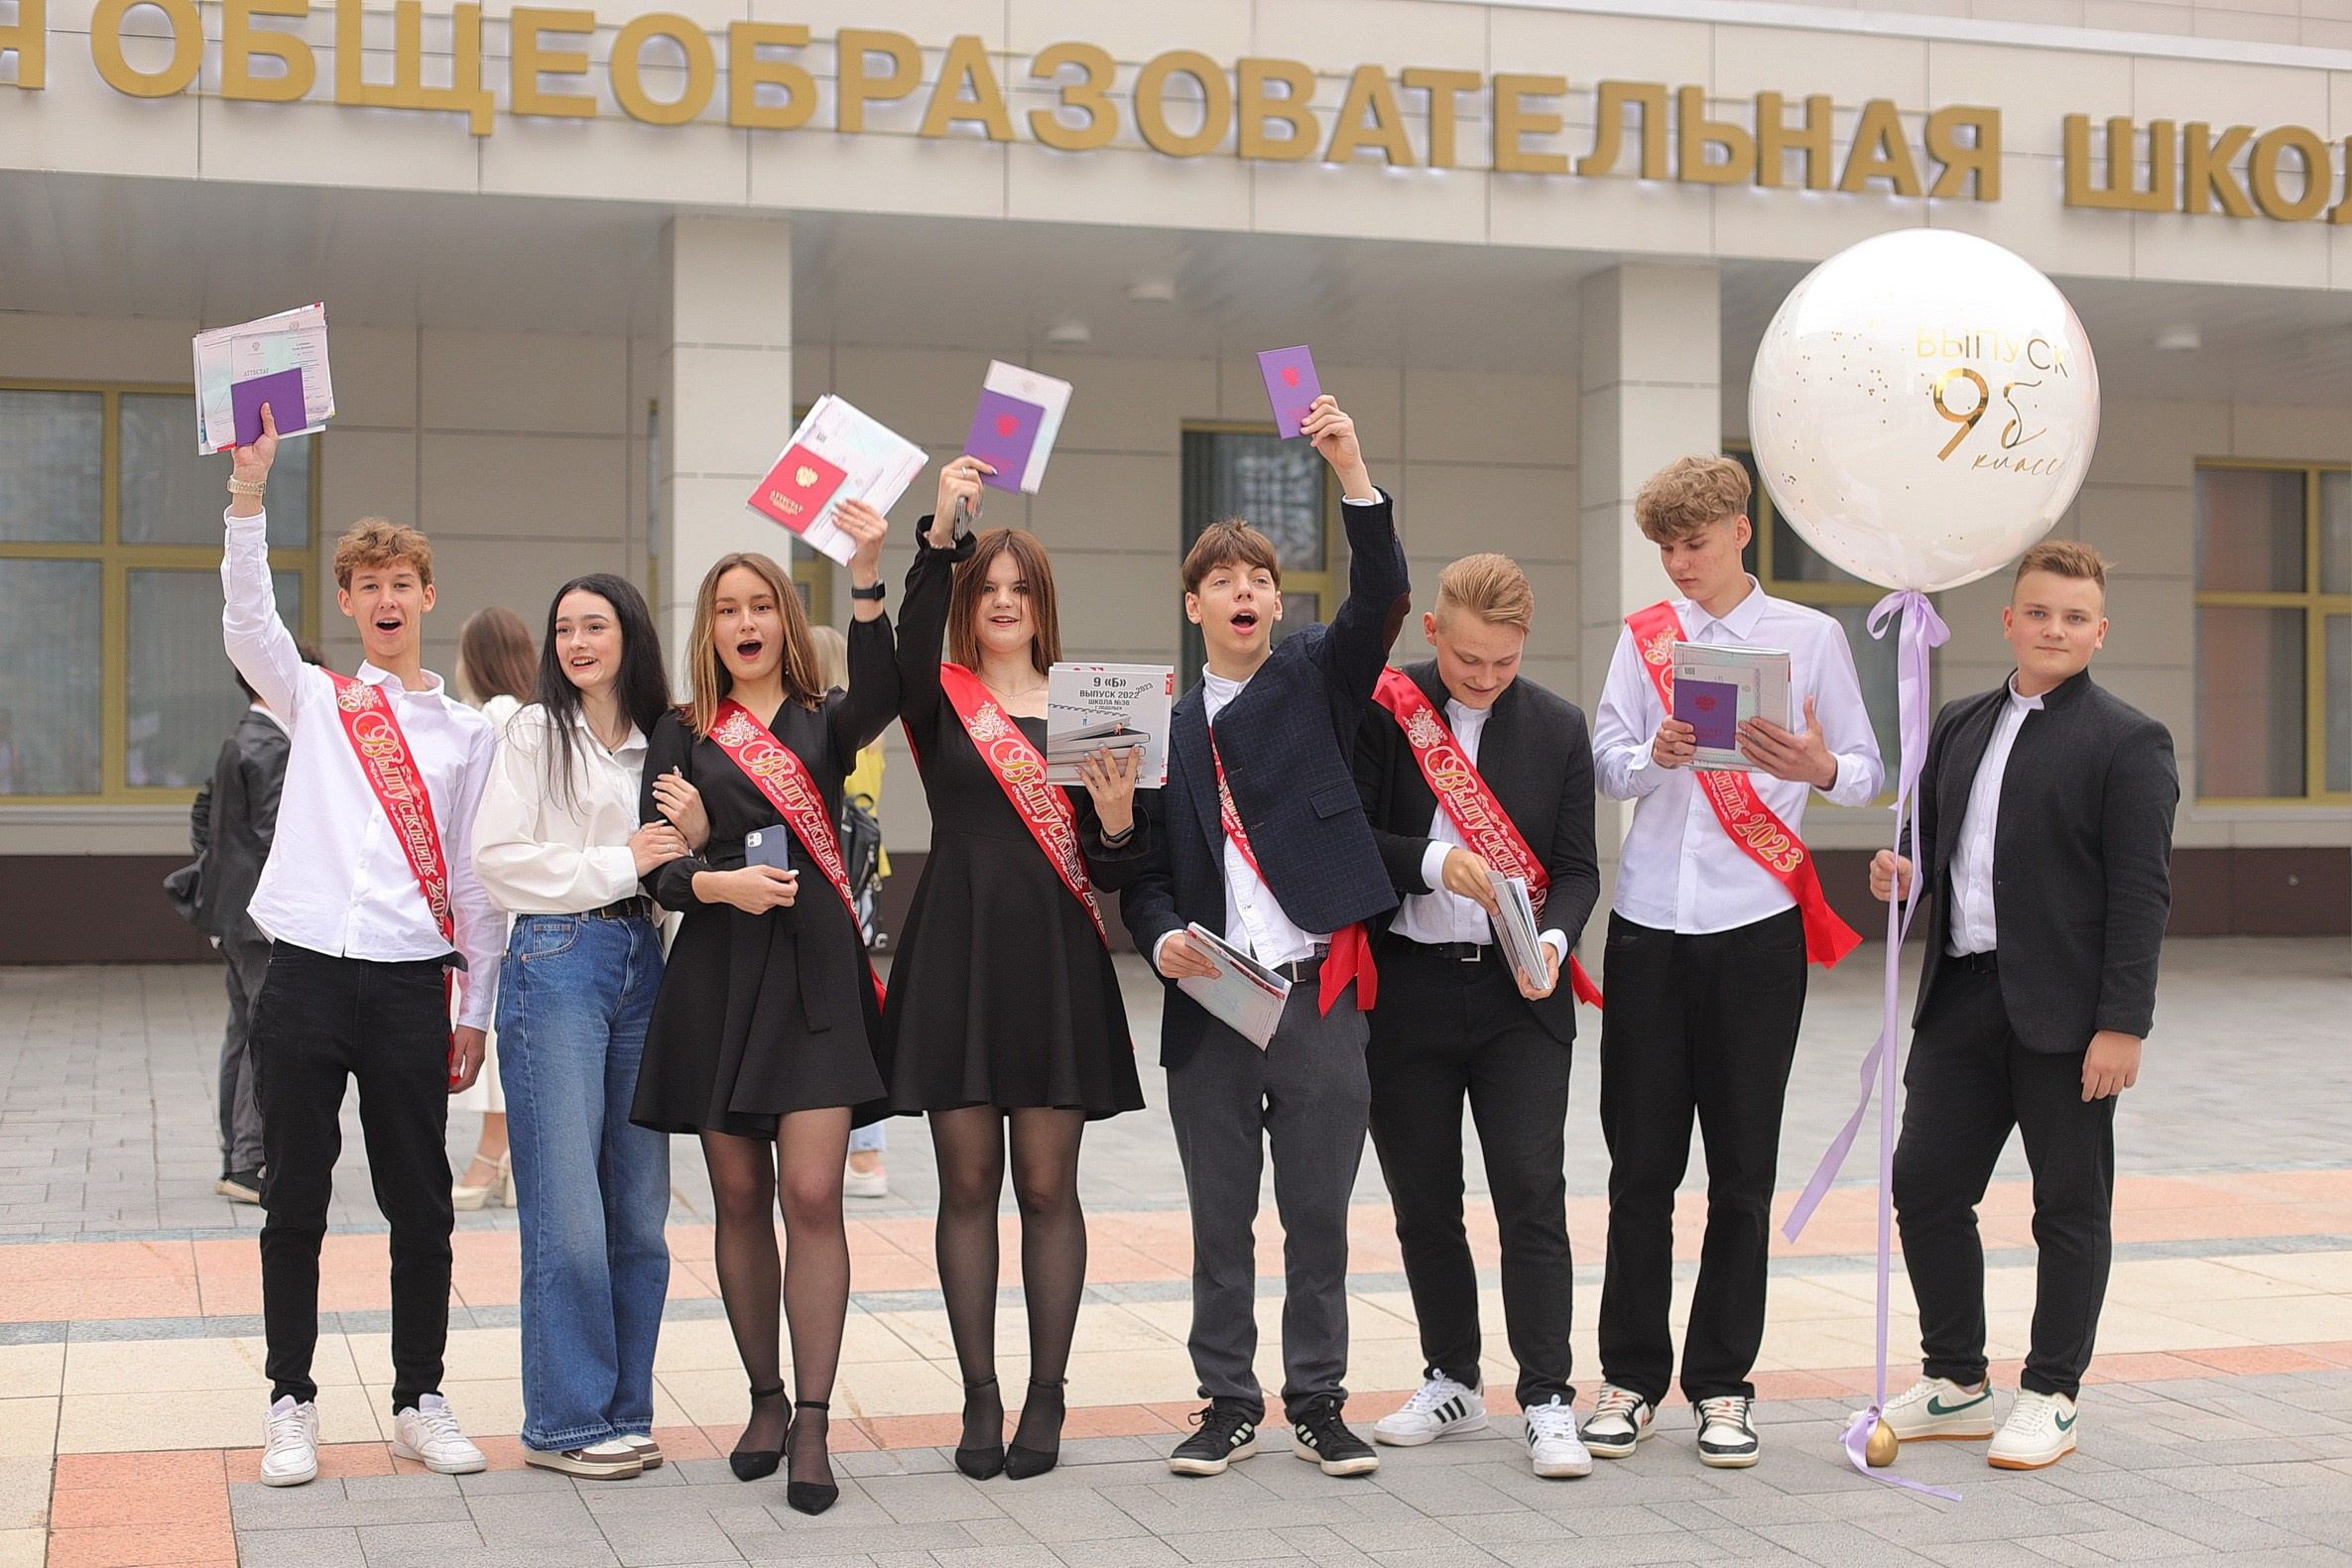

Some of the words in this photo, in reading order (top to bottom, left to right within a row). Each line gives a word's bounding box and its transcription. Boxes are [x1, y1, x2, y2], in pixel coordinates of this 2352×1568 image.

[90, 0, 2002, 203] ОБЩЕОБРАЗОВАТЕЛЬНАЯ
[2063, 112, 2352, 225] ШКО
[1917, 327, 2068, 378] ВЫПУСК
[1079, 689, 1116, 698] ВЫПУСК
[1117, 690, 1140, 699] 2022
[1135, 682, 1154, 694] 2023
[1093, 676, 1101, 687] 9
[1732, 813, 1803, 873] 2023
